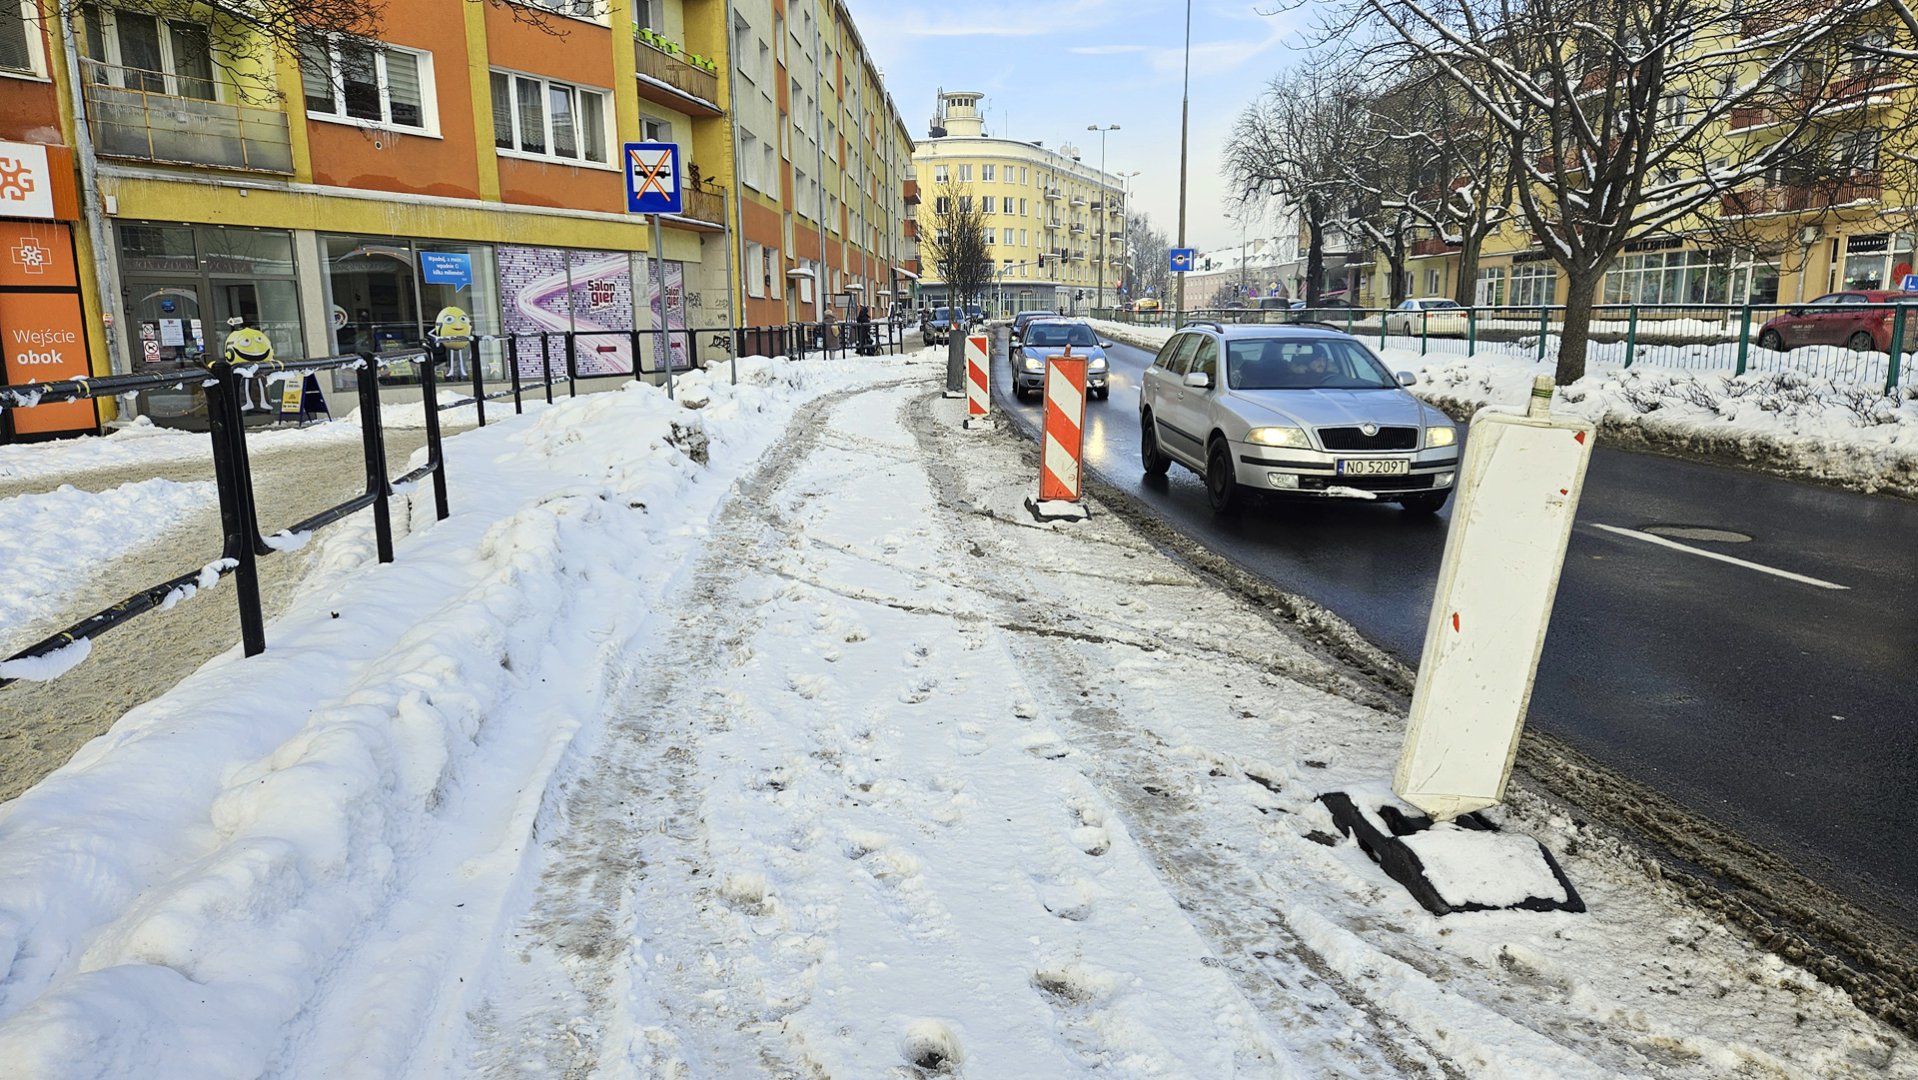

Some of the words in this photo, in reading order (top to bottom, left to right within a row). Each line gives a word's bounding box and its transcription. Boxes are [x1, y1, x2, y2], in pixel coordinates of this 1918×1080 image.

[588, 280, 615, 291] Salon
[1908, 277, 1916, 289] L
[665, 286, 679, 297] Salon
[591, 292, 615, 306] gier
[667, 296, 679, 308] gier
[13, 329, 75, 347] Wejście
[17, 349, 63, 365] obok
[1346, 461, 1364, 473] NO
[1368, 461, 1406, 473] 5209T
